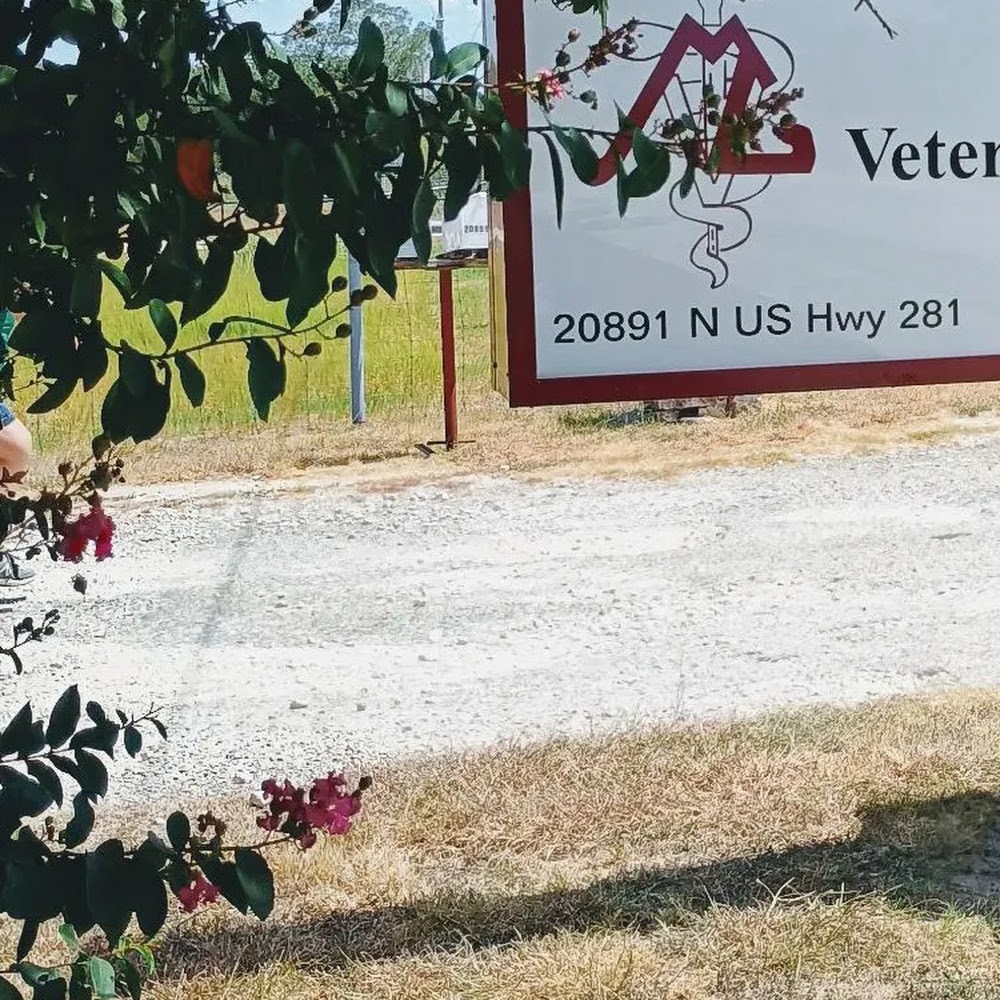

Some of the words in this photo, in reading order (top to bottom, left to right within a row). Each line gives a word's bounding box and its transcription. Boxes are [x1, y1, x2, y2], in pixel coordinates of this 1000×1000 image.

[553, 310, 667, 344] 20891
[690, 306, 718, 338] N
[735, 303, 792, 337] US
[807, 302, 886, 339] Hwy
[899, 298, 959, 329] 281
